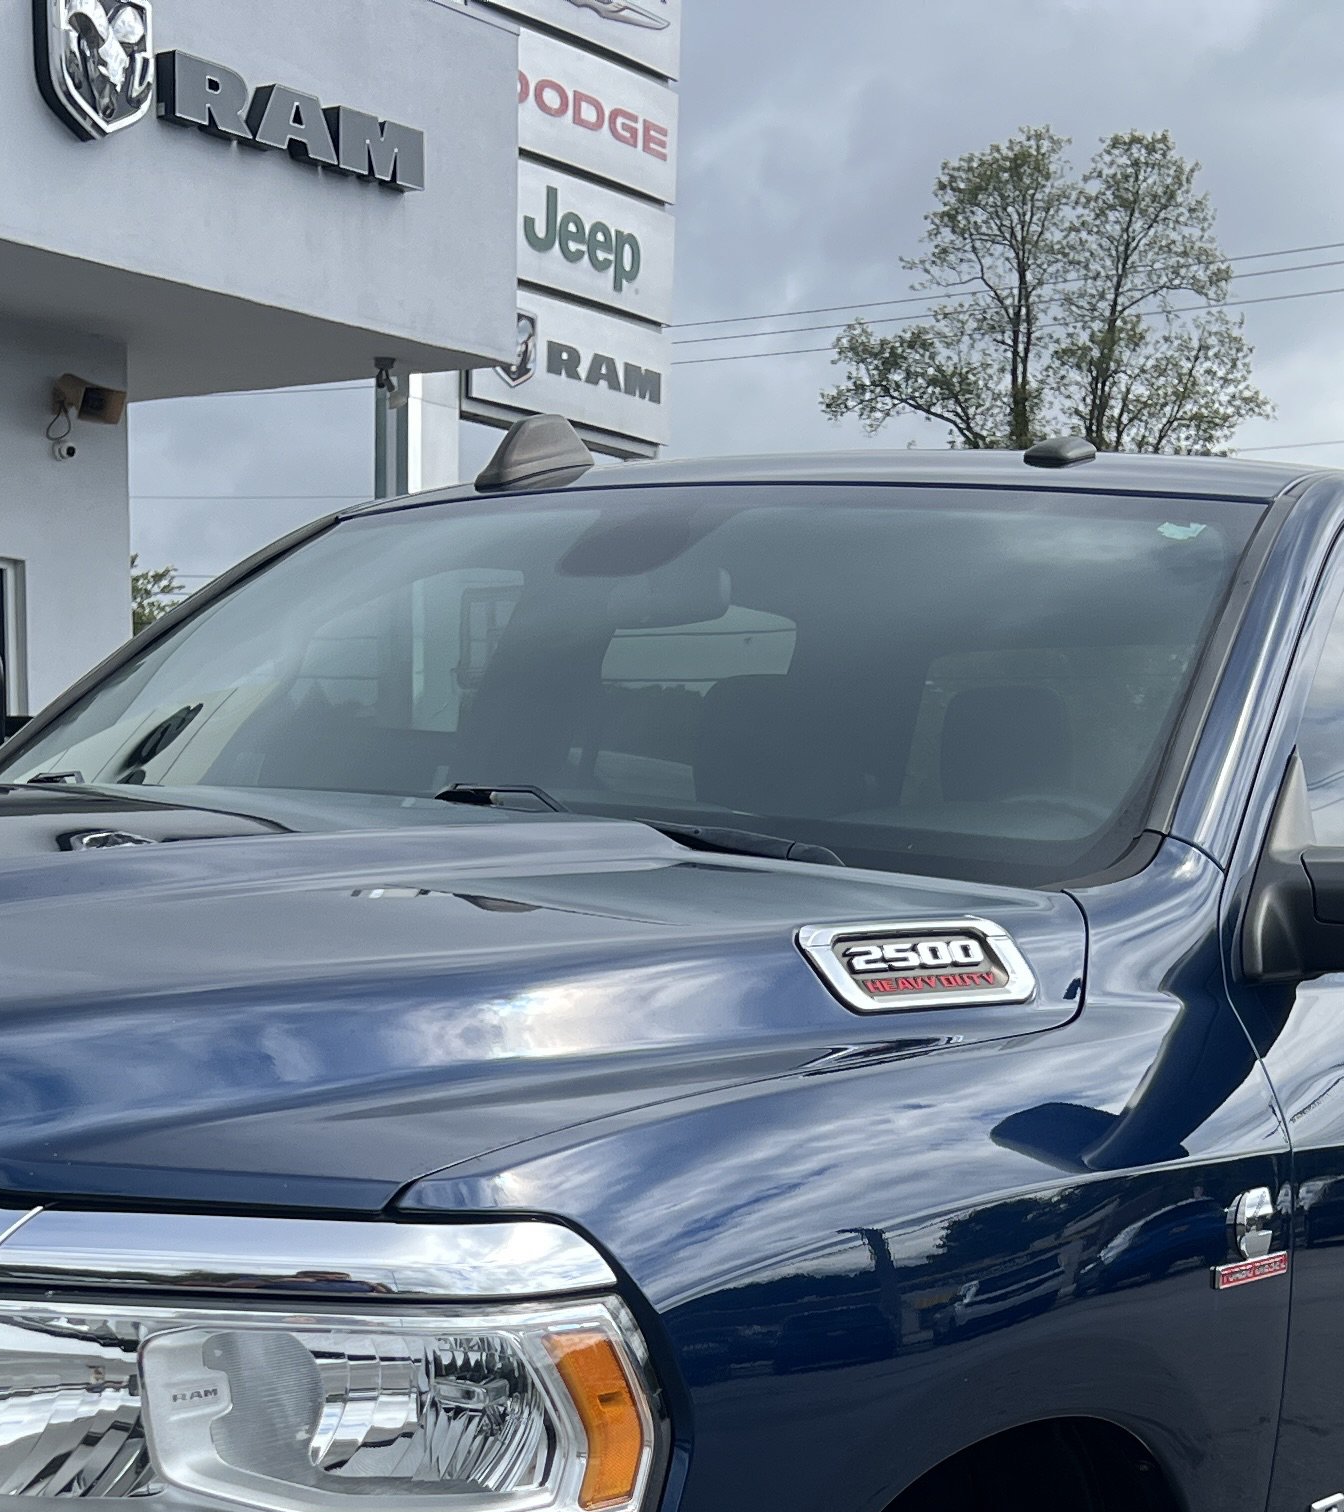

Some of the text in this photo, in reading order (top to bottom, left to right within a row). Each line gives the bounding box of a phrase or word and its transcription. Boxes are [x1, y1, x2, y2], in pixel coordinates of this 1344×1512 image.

[156, 49, 425, 192] RAM
[523, 184, 641, 293] Jeep
[546, 339, 662, 405] RAM
[843, 939, 985, 974] 2500
[863, 972, 996, 993] HEAVY DUTY
[172, 1388, 219, 1403] RAM
